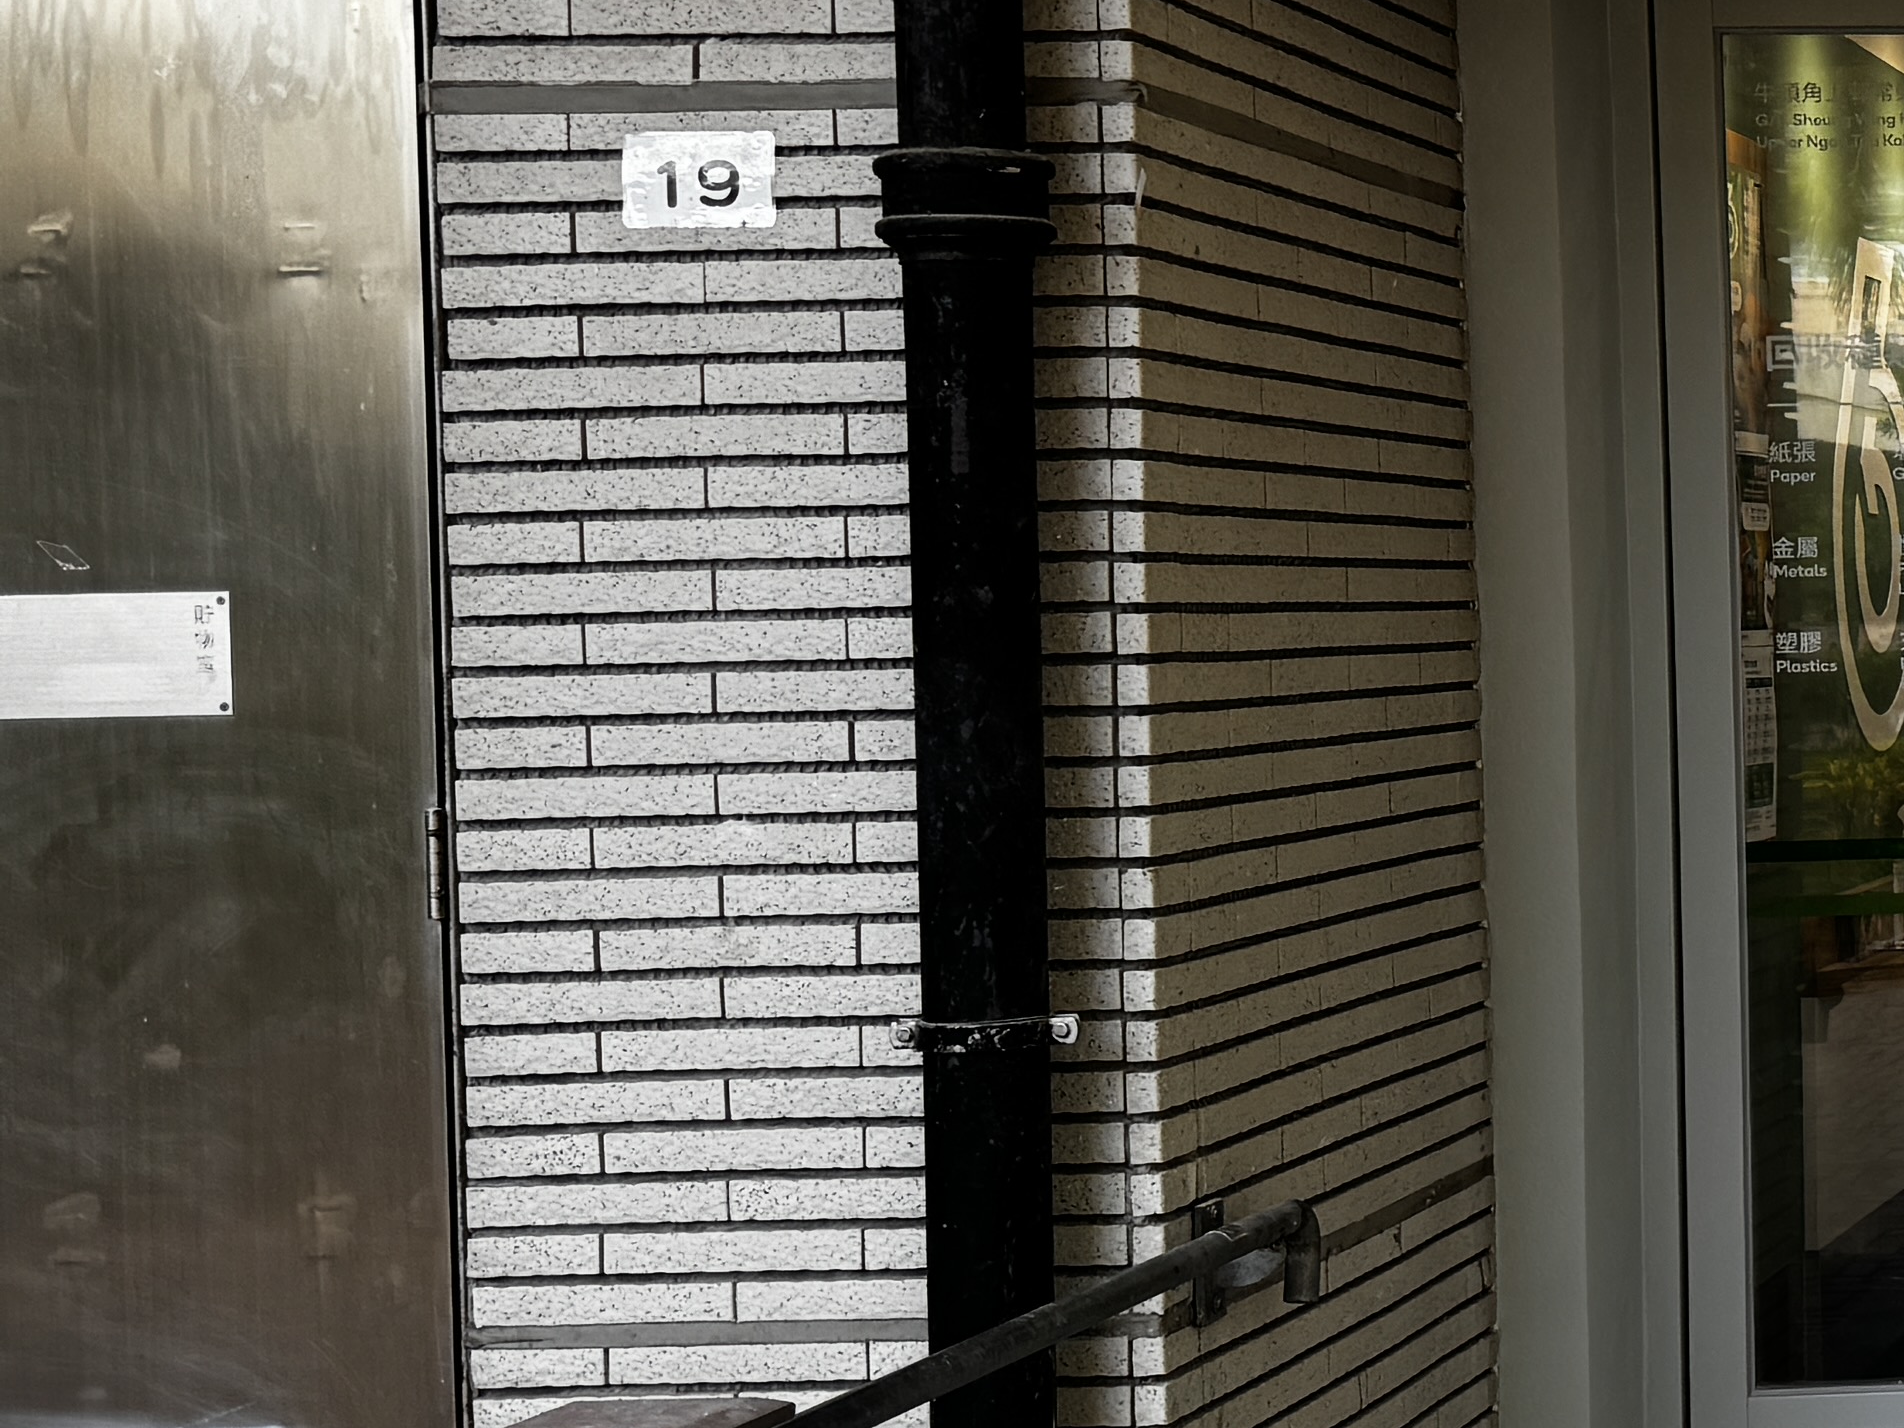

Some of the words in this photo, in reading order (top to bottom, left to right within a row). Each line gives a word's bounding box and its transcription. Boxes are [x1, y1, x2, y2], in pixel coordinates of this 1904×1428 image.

[1756, 135, 1803, 151] Uper
[656, 159, 740, 209] 19
[1768, 441, 1816, 464] 紙張
[1770, 470, 1816, 485] Paper
[1772, 536, 1819, 559] 金屬
[1773, 563, 1828, 578] Metals
[193, 604, 215, 682] 貯物
[1775, 631, 1822, 654] 塑膠
[1776, 658, 1838, 674] Plastics
